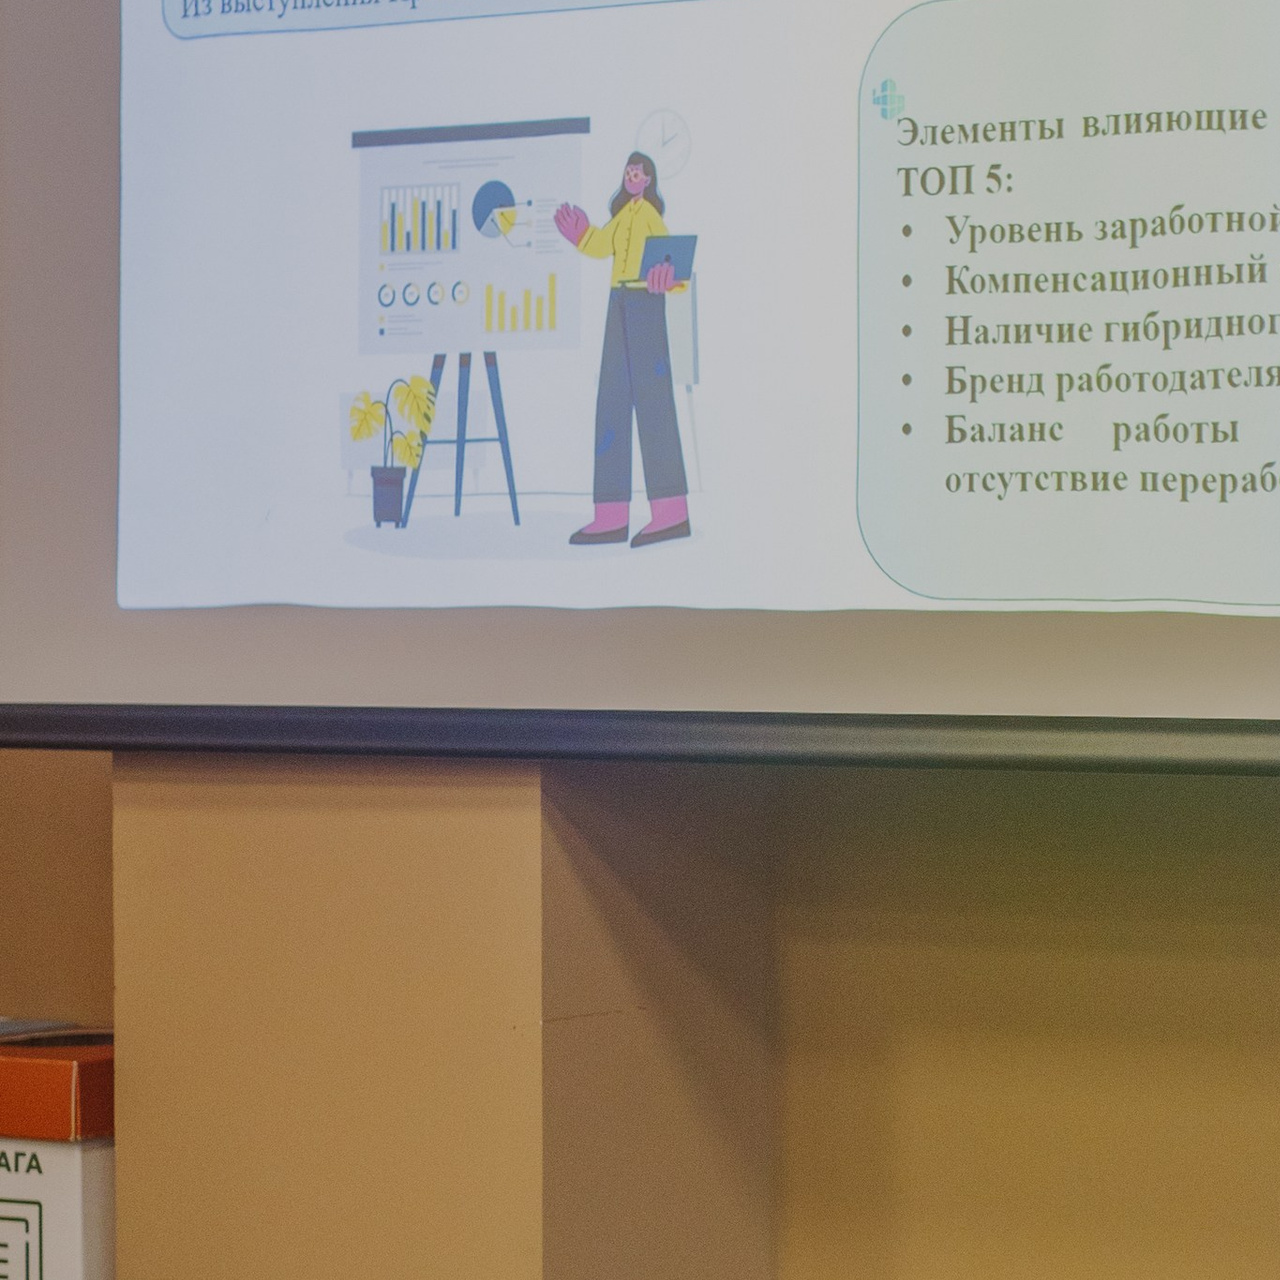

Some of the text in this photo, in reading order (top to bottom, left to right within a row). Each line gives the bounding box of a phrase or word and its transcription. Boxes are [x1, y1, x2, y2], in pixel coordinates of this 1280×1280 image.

[896, 116, 1065, 147] Элементы
[1082, 108, 1268, 139] влияющие
[896, 162, 1014, 198] ТОП 5:
[945, 214, 1084, 254] Уровень
[945, 253, 1268, 296] Компенсационный
[945, 314, 1094, 347] Наличие
[945, 365, 1045, 404] Бренд
[945, 413, 1064, 445] Баланс
[1112, 412, 1240, 452] работы
[944, 470, 1129, 502] отсутствие
